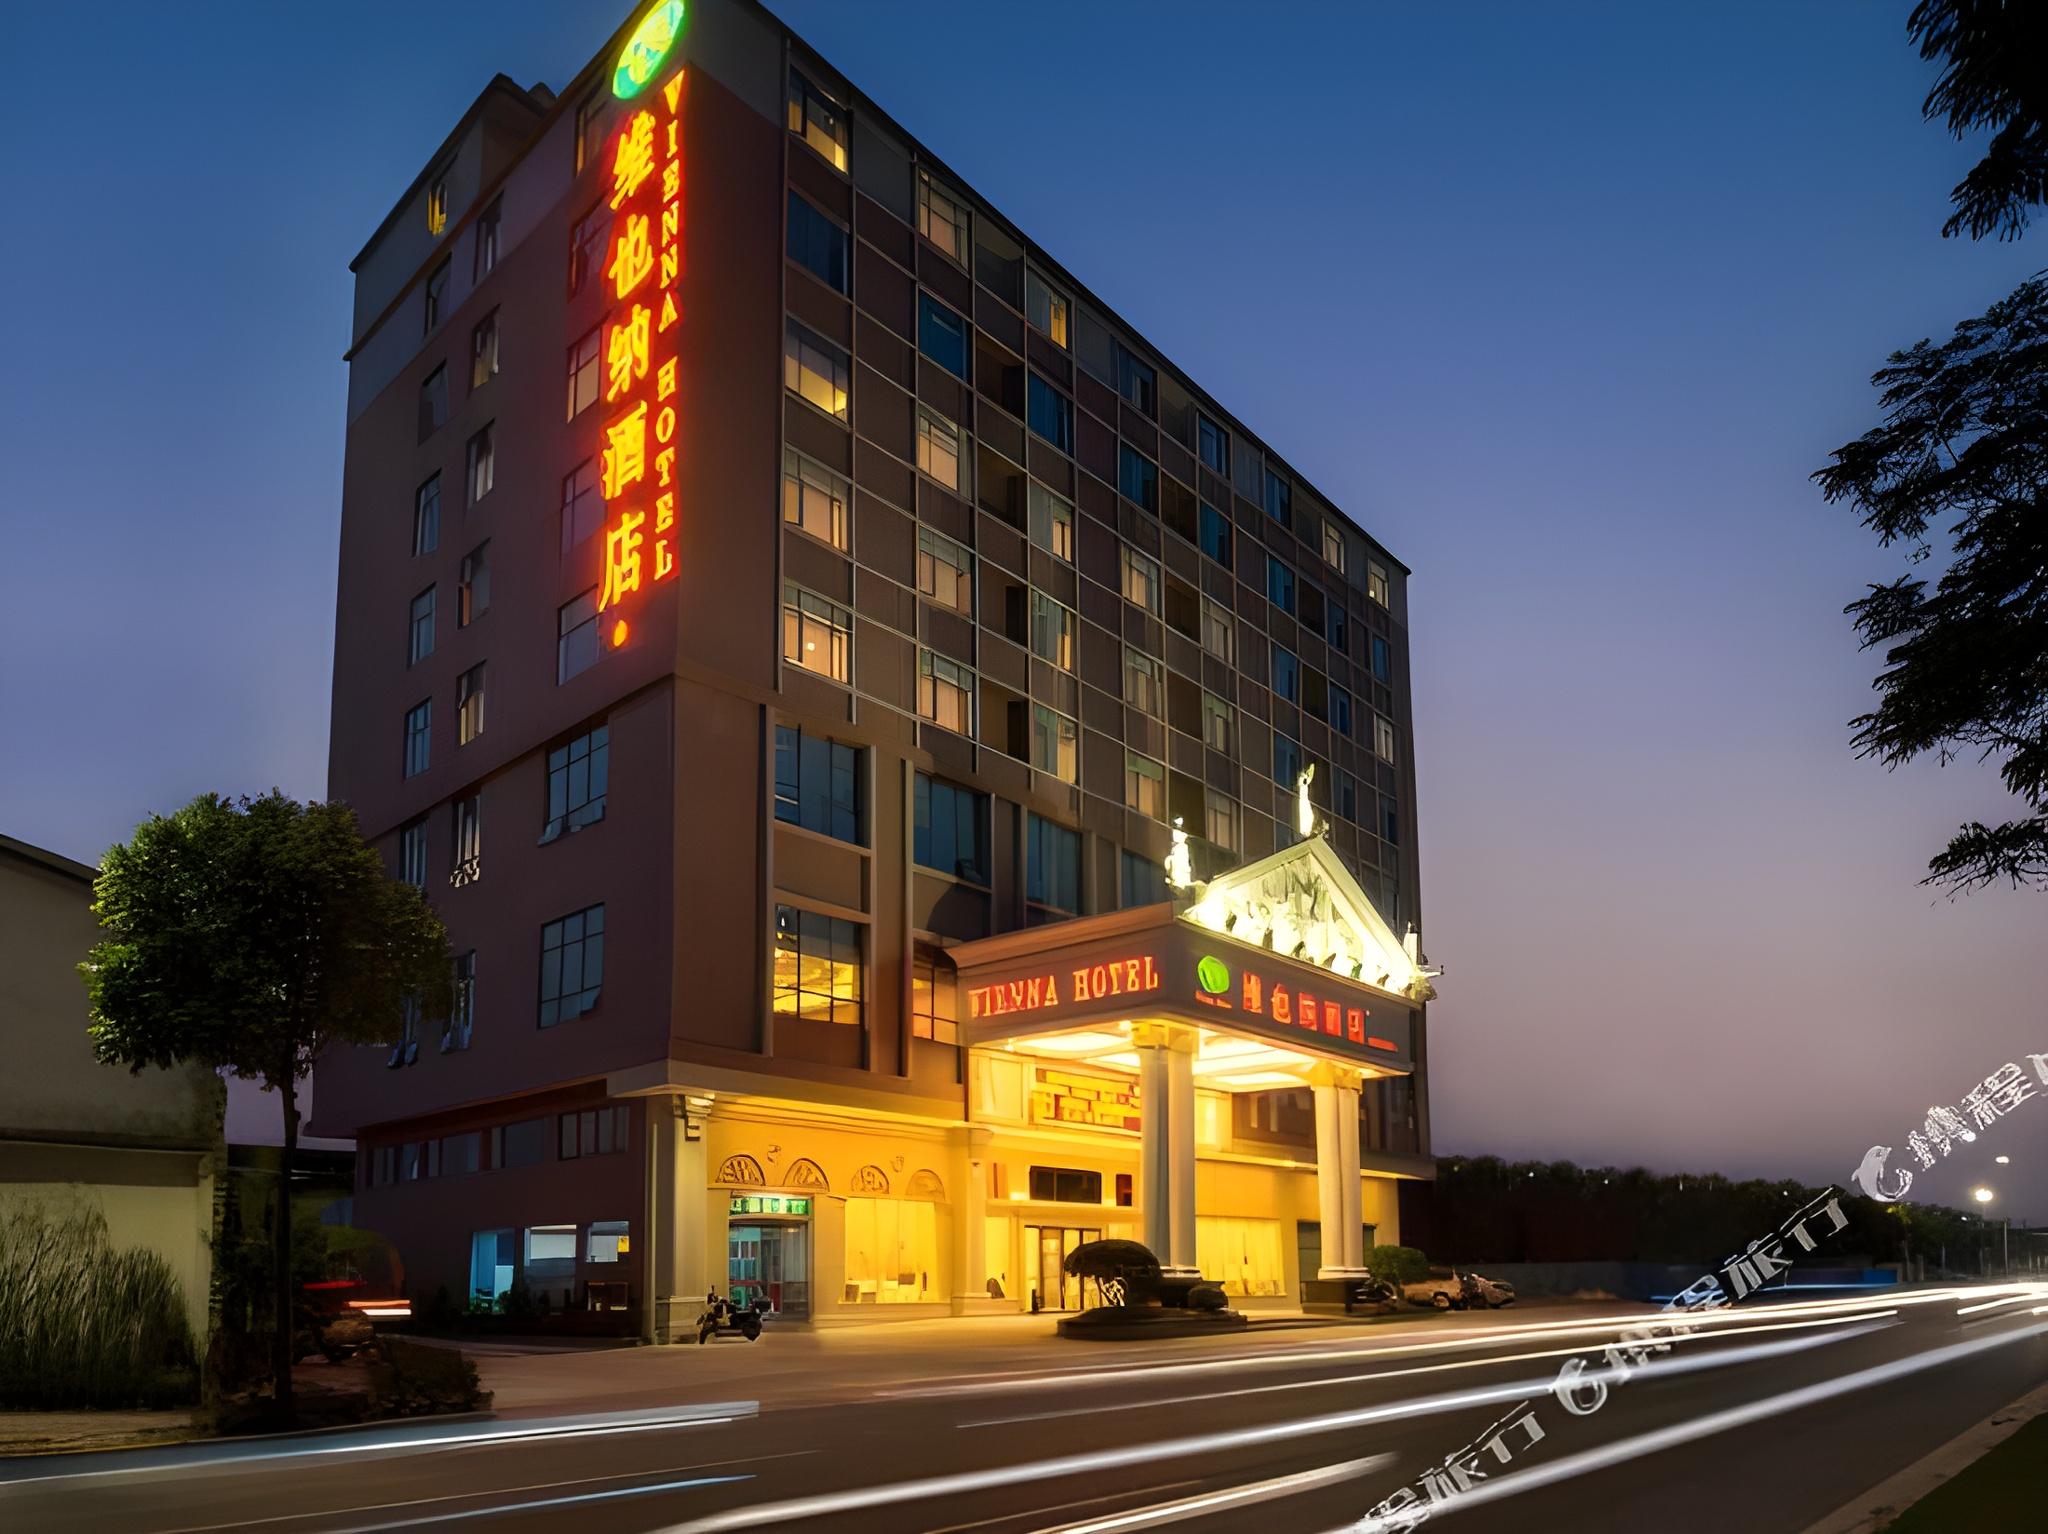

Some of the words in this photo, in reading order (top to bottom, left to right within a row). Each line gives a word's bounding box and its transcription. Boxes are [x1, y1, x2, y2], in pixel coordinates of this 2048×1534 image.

[598, 109, 656, 614] 维也纳酒店
[653, 355, 679, 581] HOTEL
[1072, 955, 1160, 1002] HOTEL
